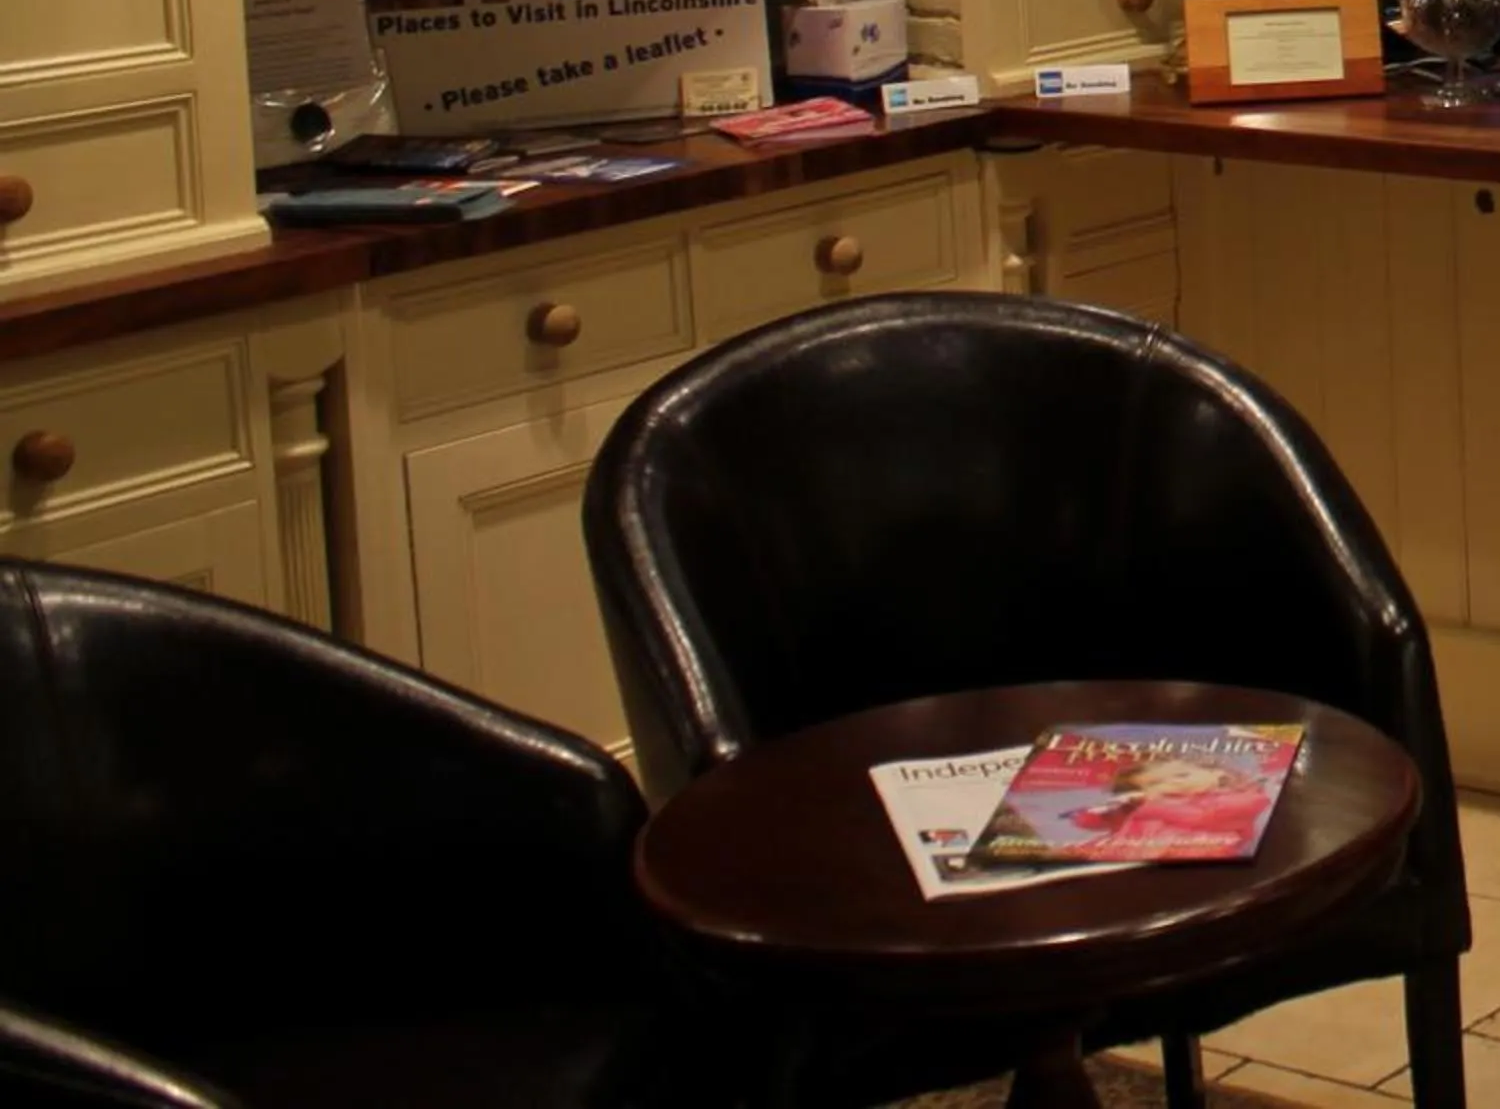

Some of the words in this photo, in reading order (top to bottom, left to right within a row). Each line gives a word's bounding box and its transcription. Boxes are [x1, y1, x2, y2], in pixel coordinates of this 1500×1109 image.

[377, 13, 460, 35] Places
[472, 10, 497, 28] to
[507, 0, 566, 24] Visit
[441, 76, 530, 113] Please
[537, 59, 594, 88] take
[603, 53, 618, 71] a
[626, 27, 709, 65] leaflet
